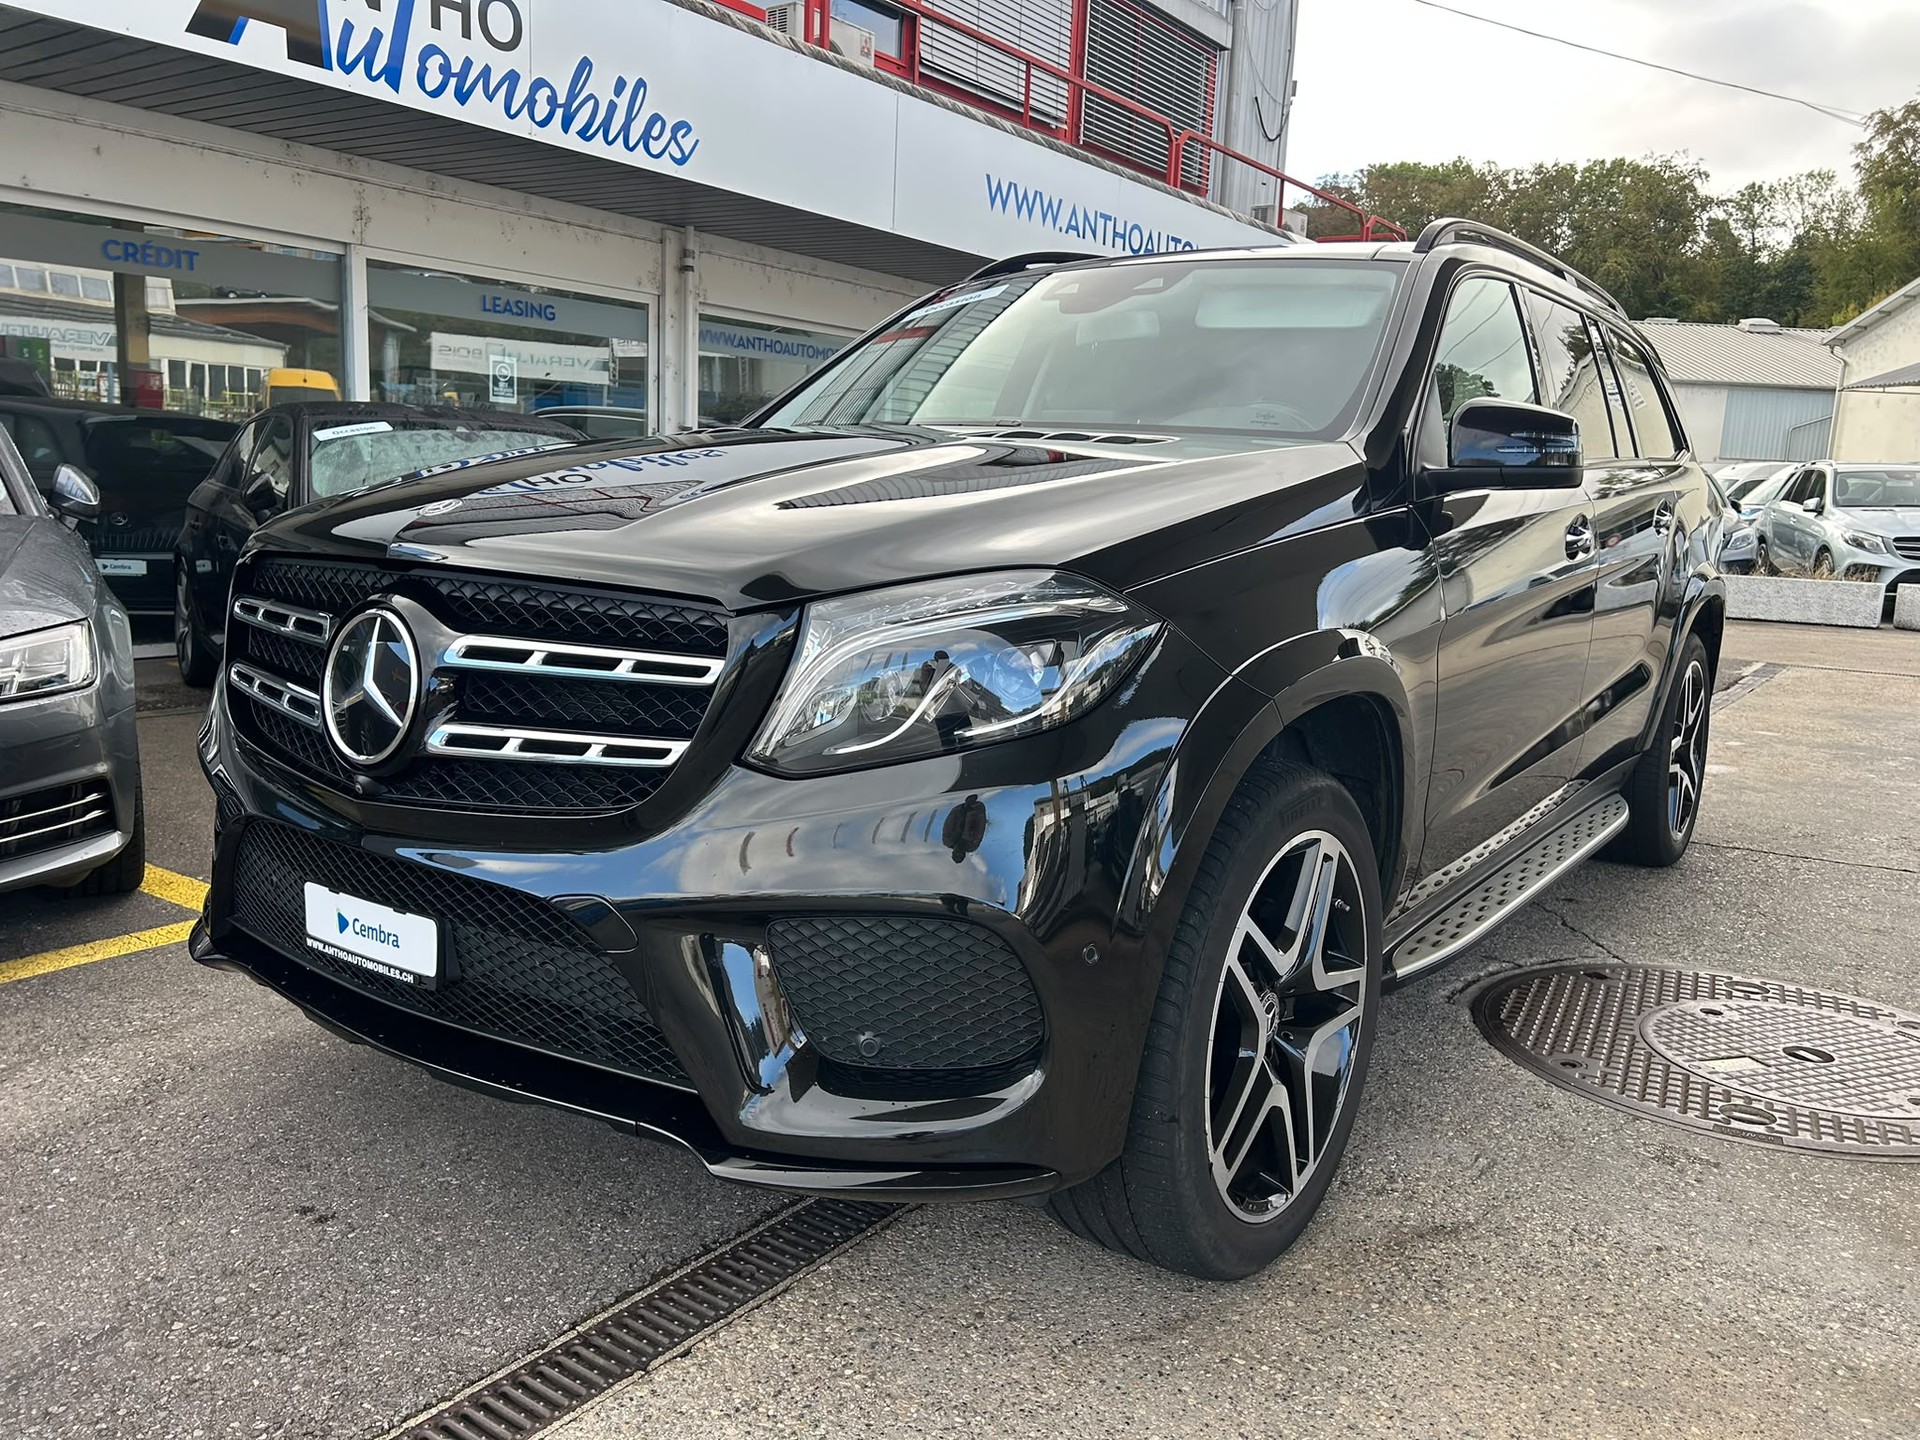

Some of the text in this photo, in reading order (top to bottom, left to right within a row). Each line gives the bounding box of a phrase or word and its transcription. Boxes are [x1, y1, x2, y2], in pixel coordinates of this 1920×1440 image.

[102, 240, 200, 271] CRÉDIT
[482, 294, 556, 321] LEASING
[352, 917, 400, 949] Cembra
[306, 937, 414, 983] WWW.ANTHOAUTOMOBILES.CH
